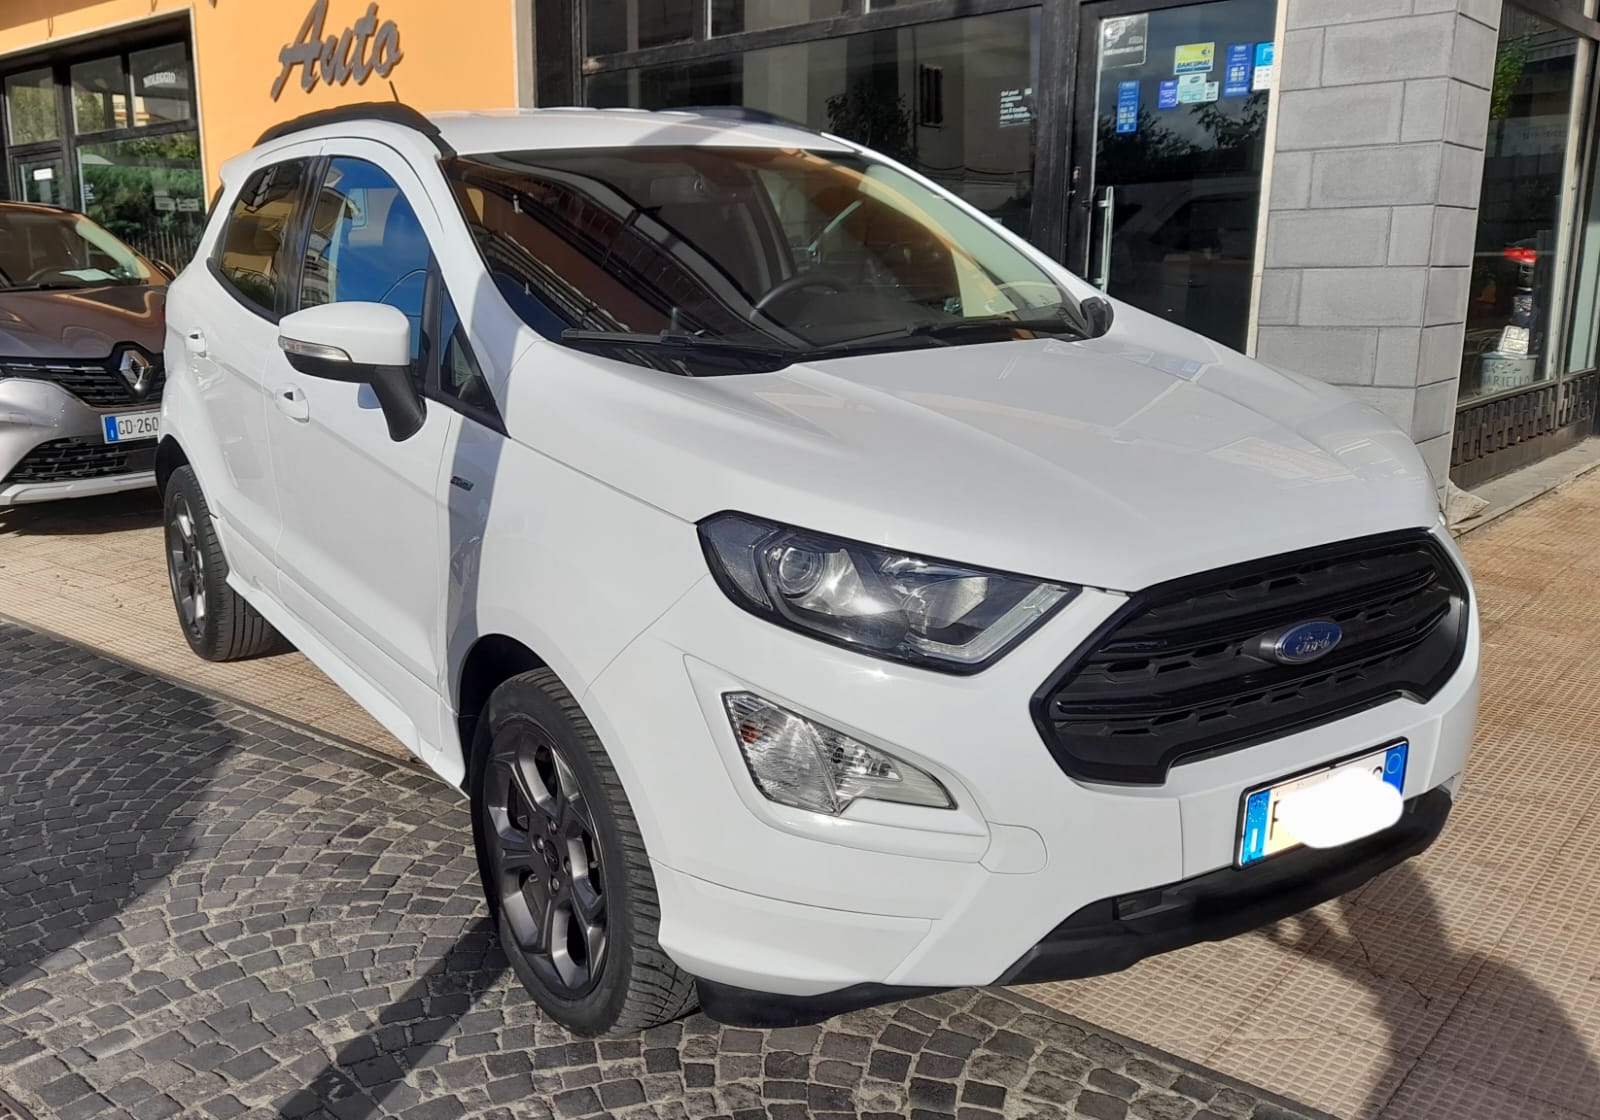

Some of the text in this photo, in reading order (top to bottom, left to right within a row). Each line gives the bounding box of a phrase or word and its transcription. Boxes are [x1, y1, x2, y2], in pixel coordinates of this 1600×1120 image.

[270, 0, 403, 102] Auto
[137, 416, 159, 433] 260
[1296, 632, 1331, 655] Ford
